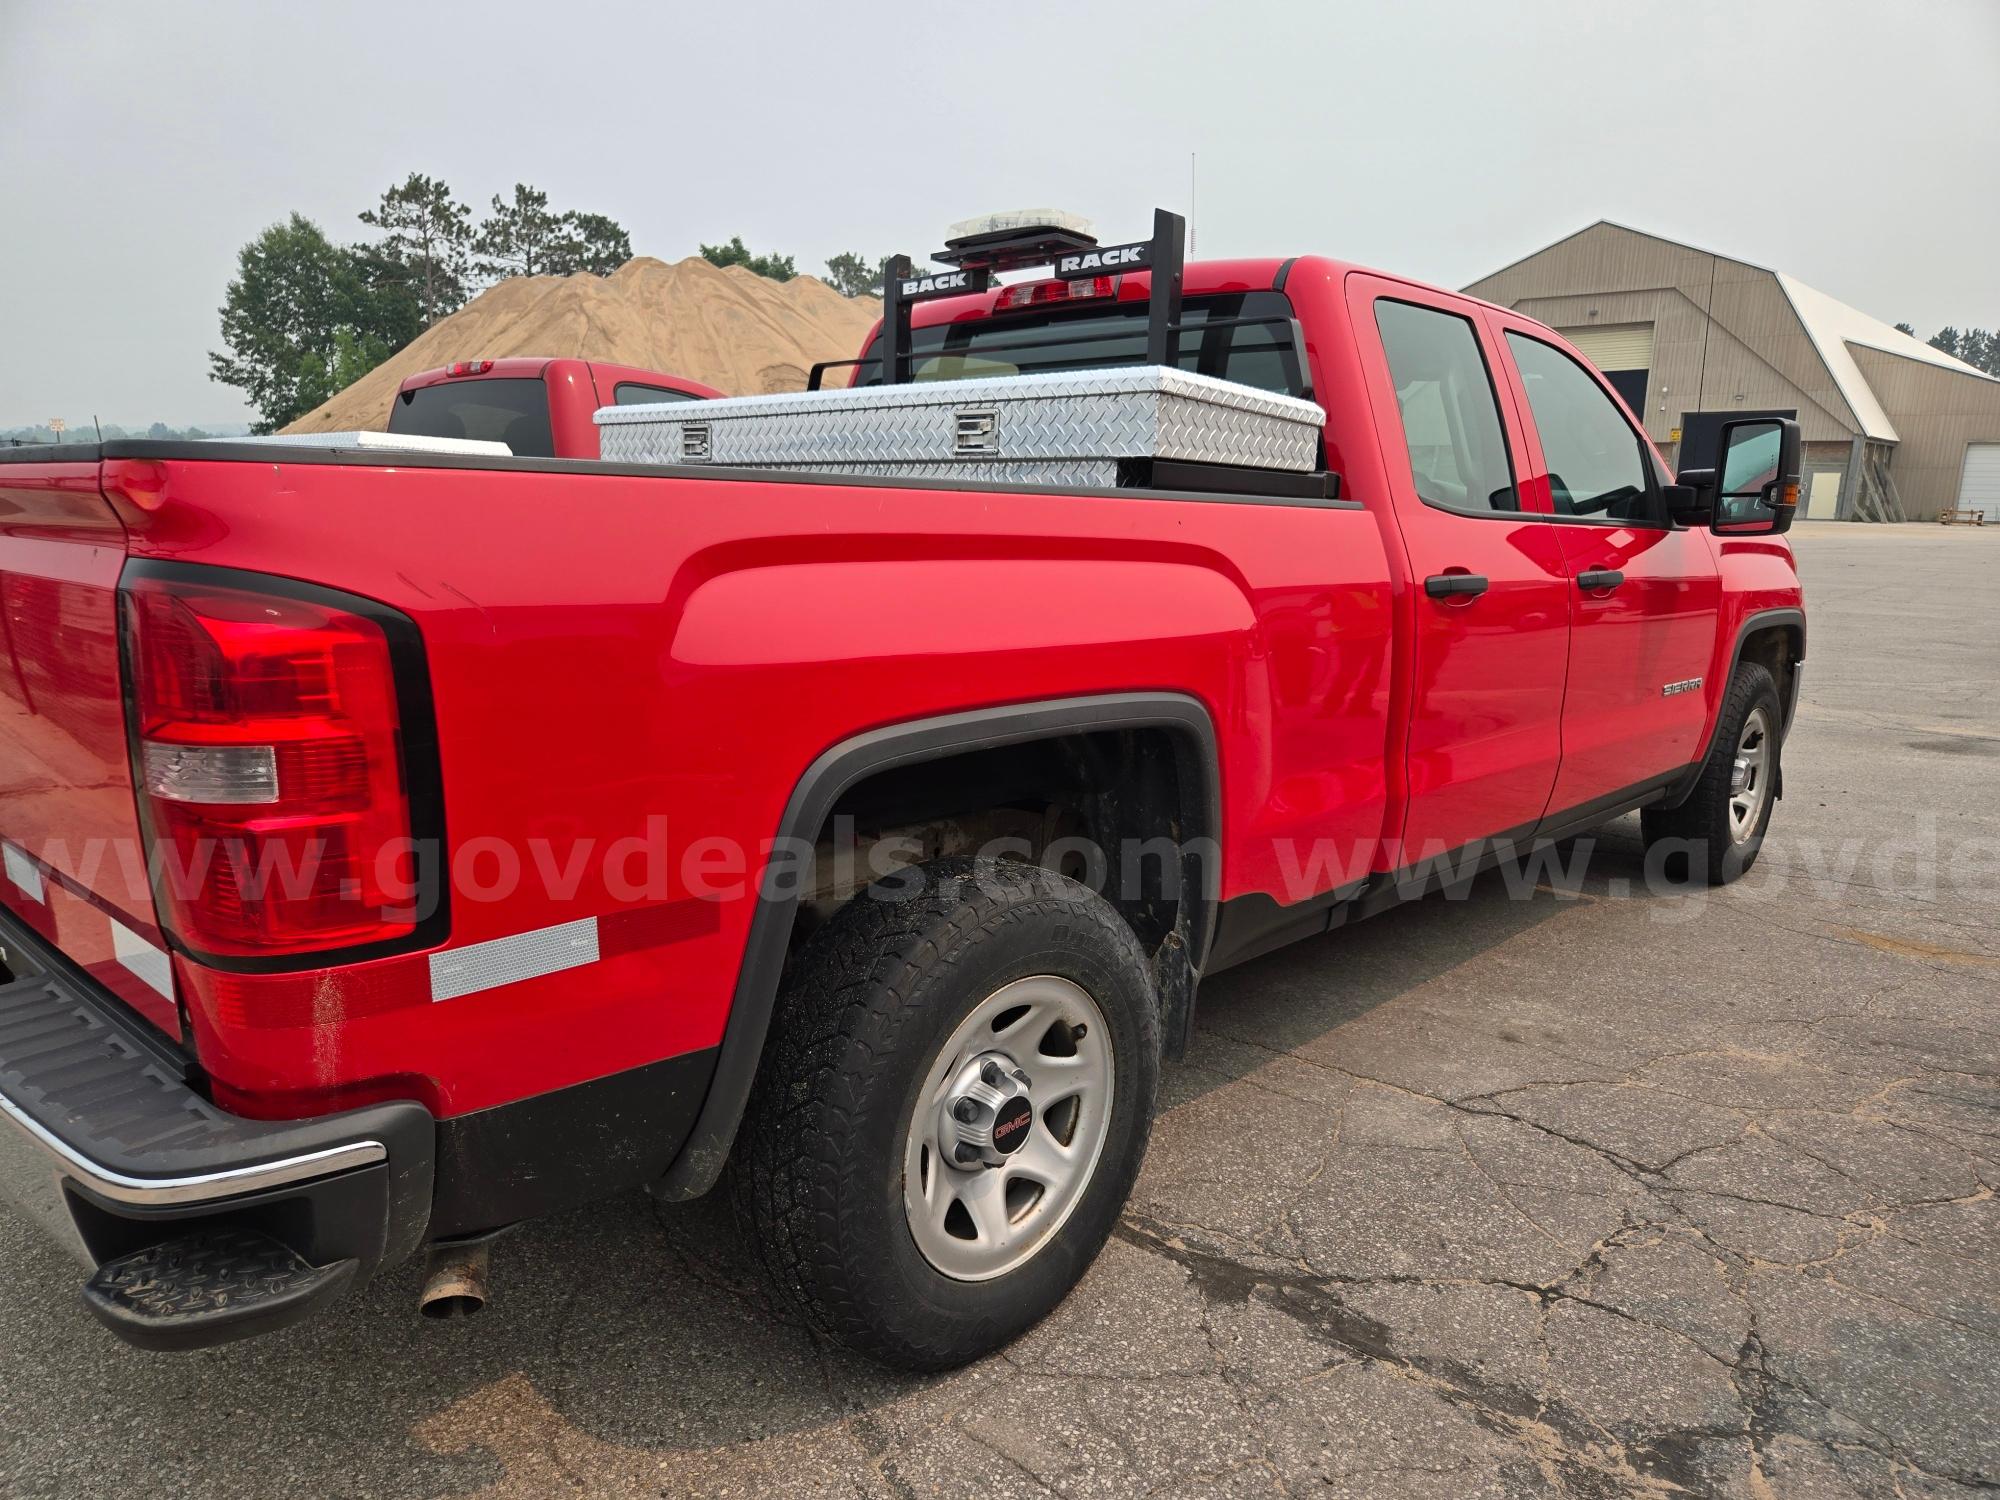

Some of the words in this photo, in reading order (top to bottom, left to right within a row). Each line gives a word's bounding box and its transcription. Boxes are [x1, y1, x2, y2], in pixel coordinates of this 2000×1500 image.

[902, 273, 967, 296] BACK
[1060, 247, 1142, 272] RACK
[1663, 678, 1703, 697] SIERRA
[994, 1111, 1031, 1139] GMC
